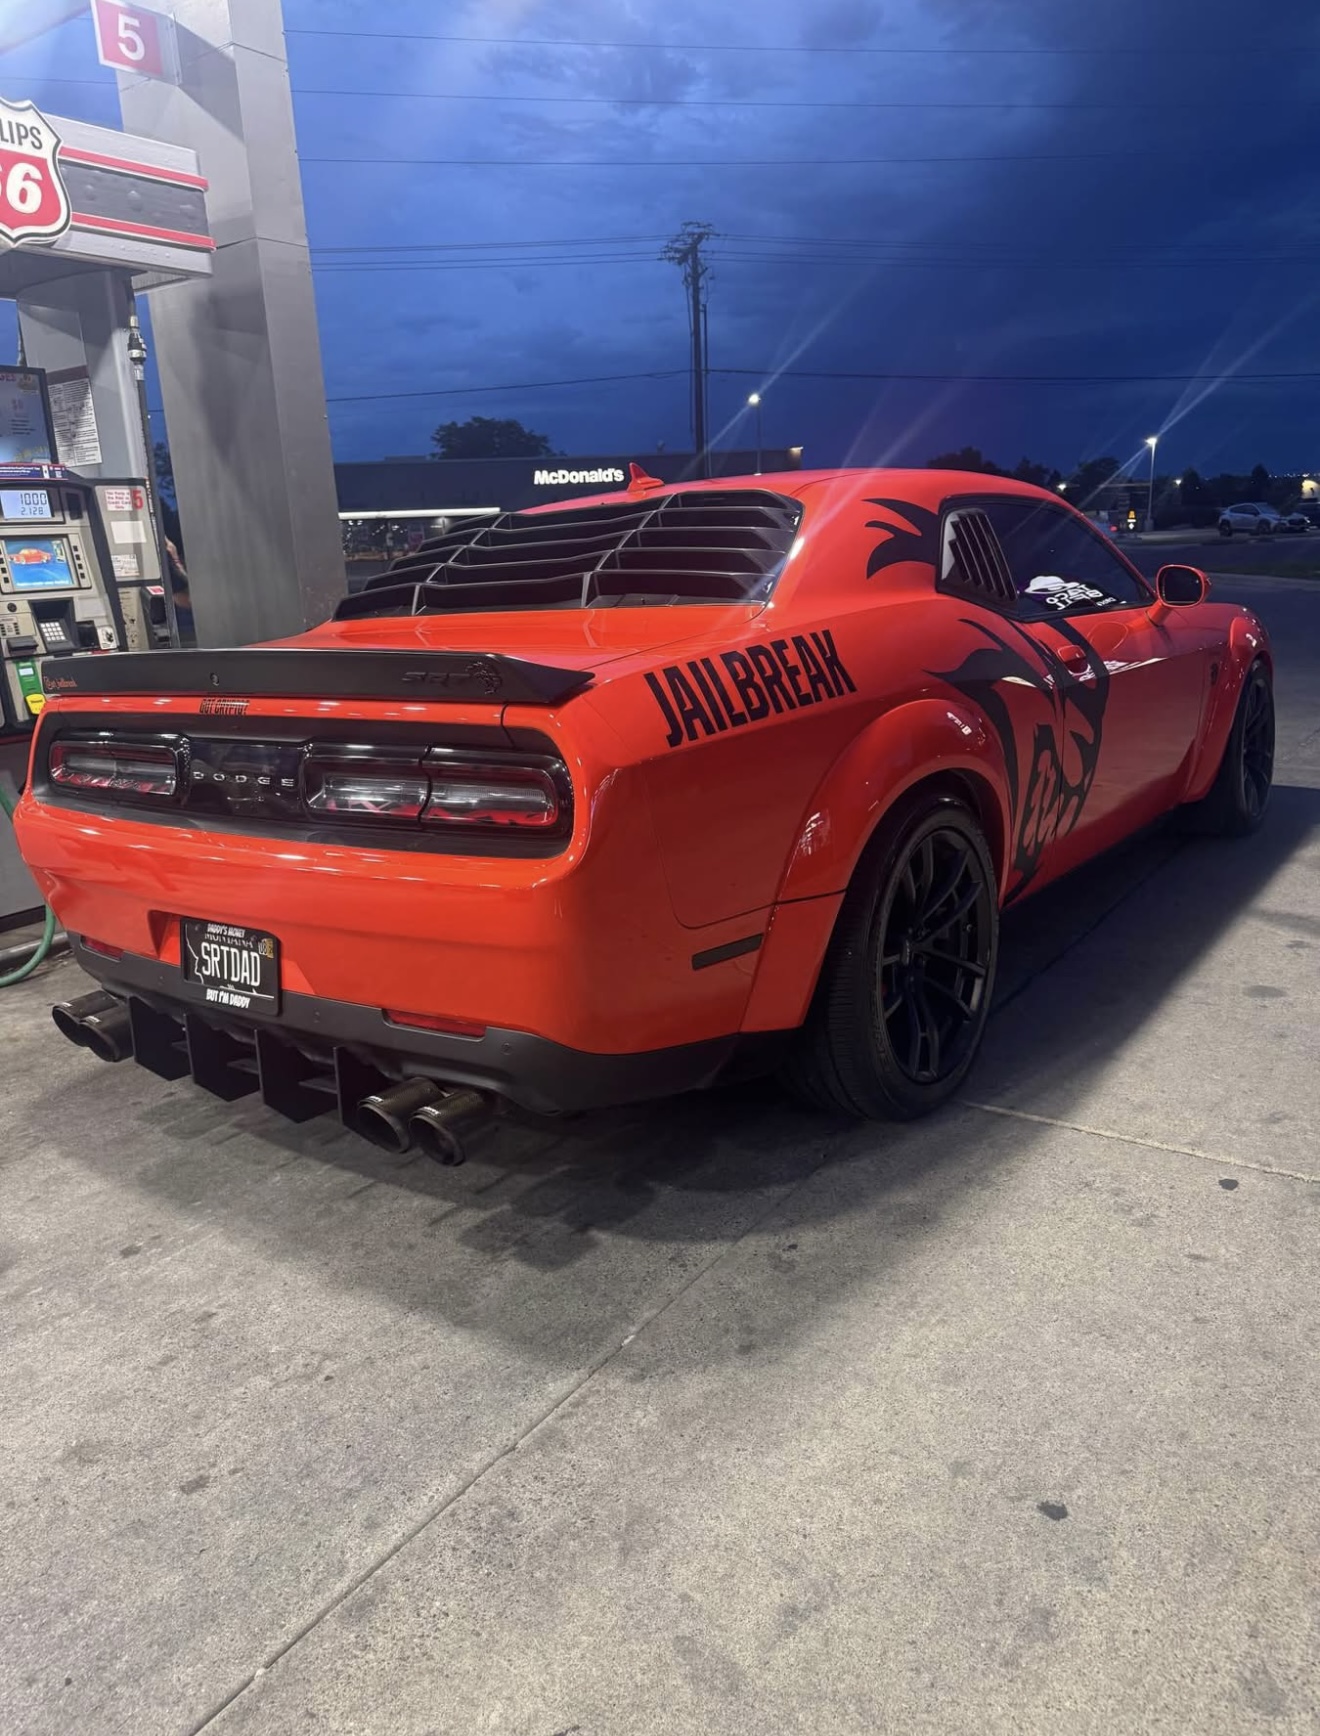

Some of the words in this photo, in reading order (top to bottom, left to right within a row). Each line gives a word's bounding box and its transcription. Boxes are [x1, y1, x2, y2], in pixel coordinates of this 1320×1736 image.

[117, 13, 145, 61] 5
[0, 162, 43, 214] 6
[534, 468, 624, 485] McDonald's
[132, 490, 144, 510] 5
[644, 629, 858, 748] JAILBREAK
[193, 771, 295, 787] DODGE
[201, 941, 260, 987] SRTDAD
